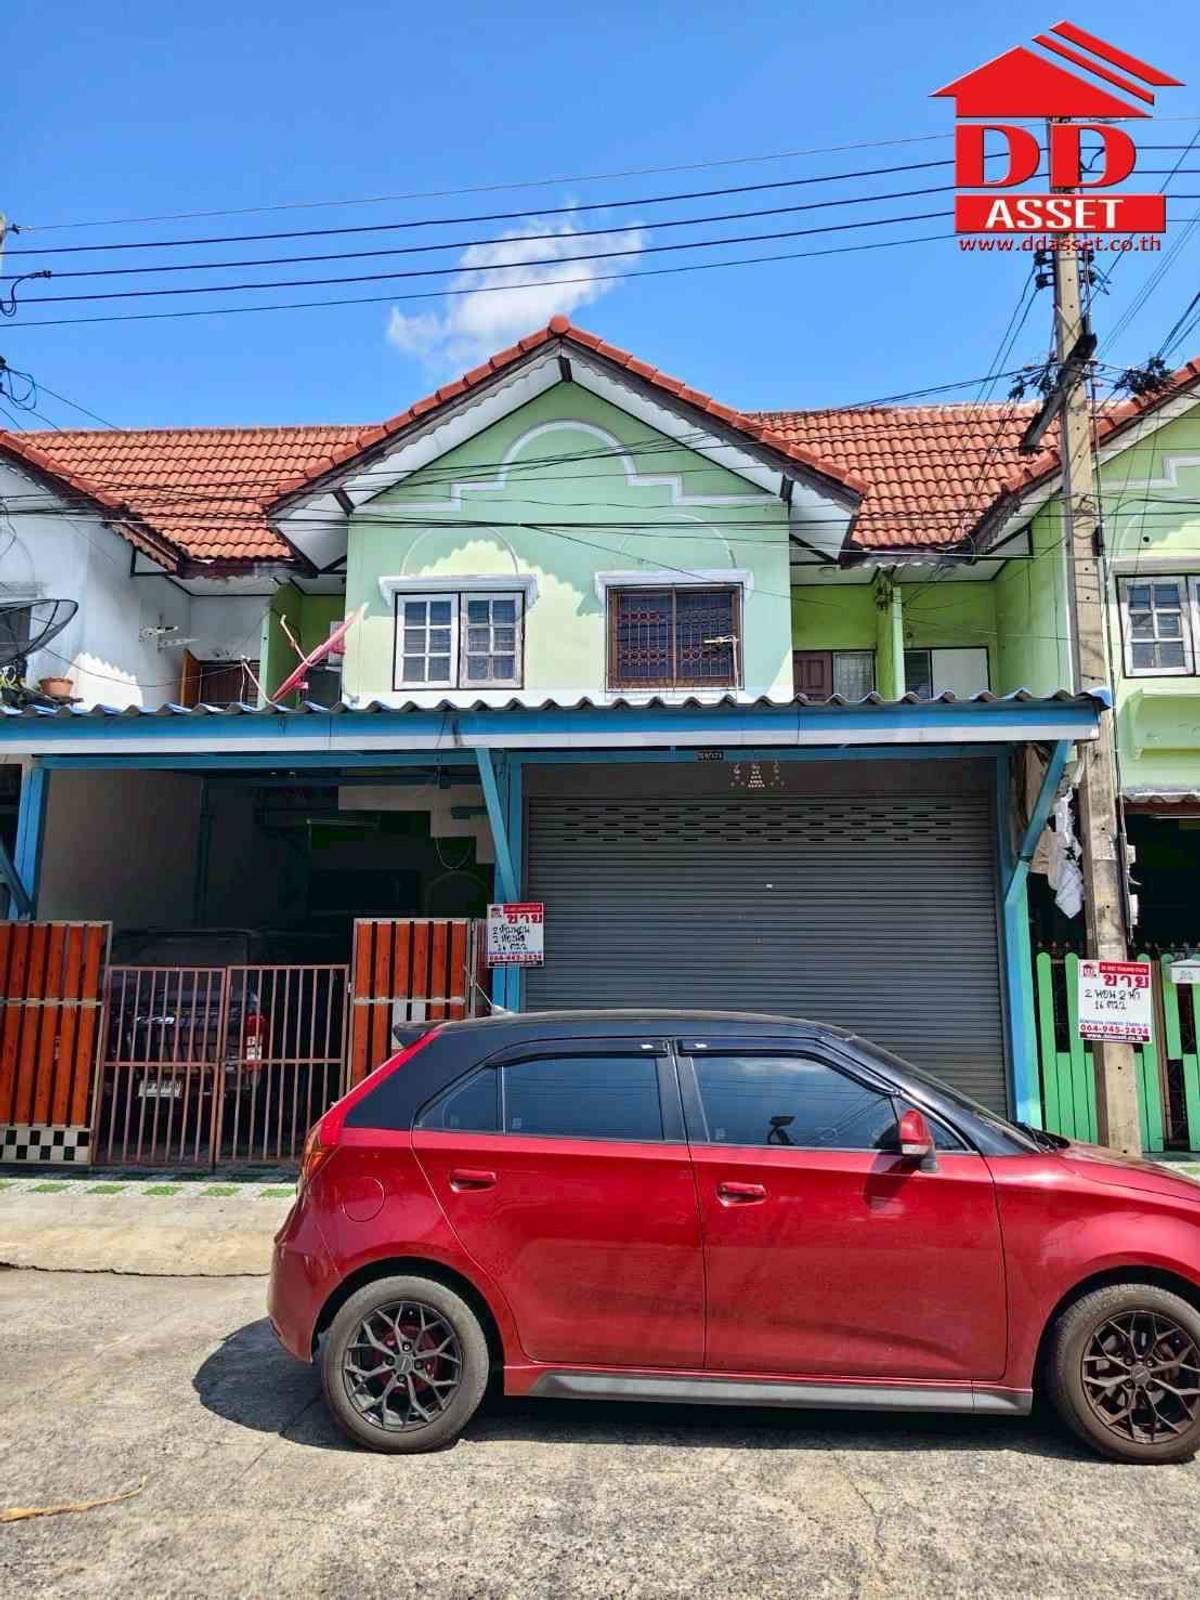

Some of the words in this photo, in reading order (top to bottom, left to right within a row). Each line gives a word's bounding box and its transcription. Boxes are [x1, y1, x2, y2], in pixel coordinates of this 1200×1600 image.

[507, 914, 542, 924] ขาย
[1103, 974, 1149, 988] ขาย
[1084, 988, 1093, 998] 2
[1118, 989, 1127, 1000] 2
[1080, 1023, 1148, 1034] 064-945-2424
